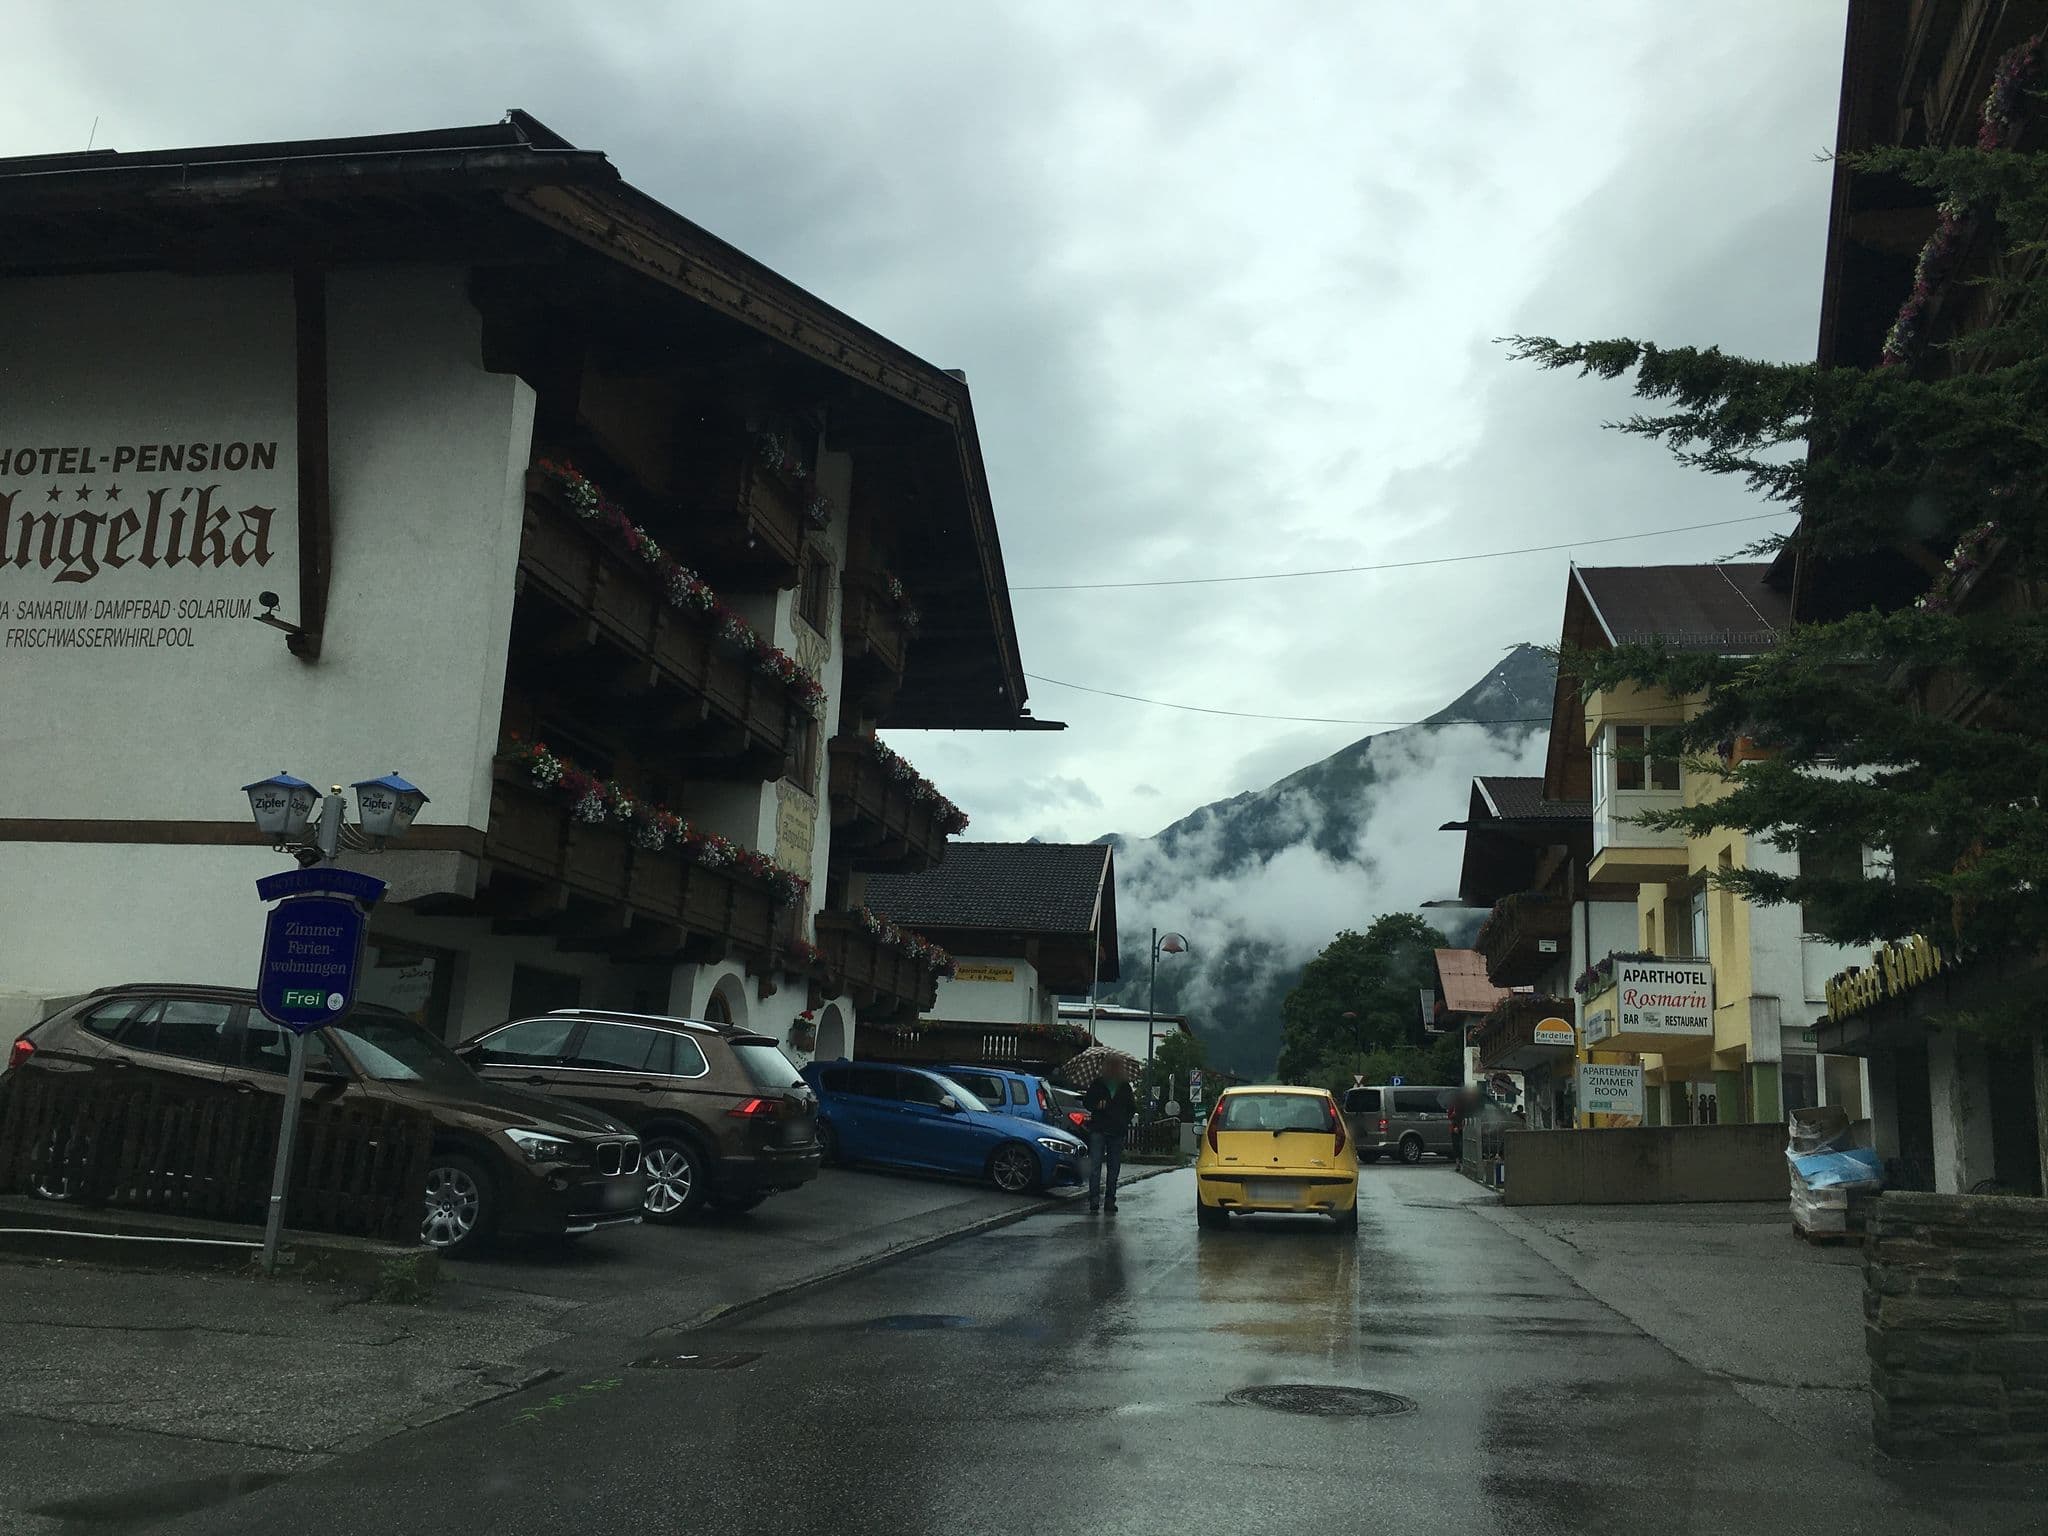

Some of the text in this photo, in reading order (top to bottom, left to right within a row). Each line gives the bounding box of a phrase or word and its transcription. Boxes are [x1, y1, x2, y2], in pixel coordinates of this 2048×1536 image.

[16, 601, 89, 620] SANARIUM
[94, 600, 171, 620] DAMPFBAD
[177, 599, 252, 619] SOLARIUM
[6, 627, 195, 649] FRISCHWASSERWHIRLPOOL
[255, 798, 287, 810] Zipfer
[362, 796, 393, 810] Zipfer
[285, 921, 344, 937] Zimmer
[287, 940, 336, 955] Ferien-
[271, 959, 347, 977] wohnungen
[1623, 969, 1707, 985] APARTHOTEL
[286, 991, 321, 1006] Frei
[1623, 988, 1708, 1009] Rosmarin
[1623, 1013, 1639, 1025] BAR
[1665, 1015, 1708, 1027] RESTAURANT
[1583, 1067, 1640, 1077] APARTEMENT
[1589, 1077, 1634, 1087] ZIMMER
[1594, 1087, 1628, 1097] ROOM
